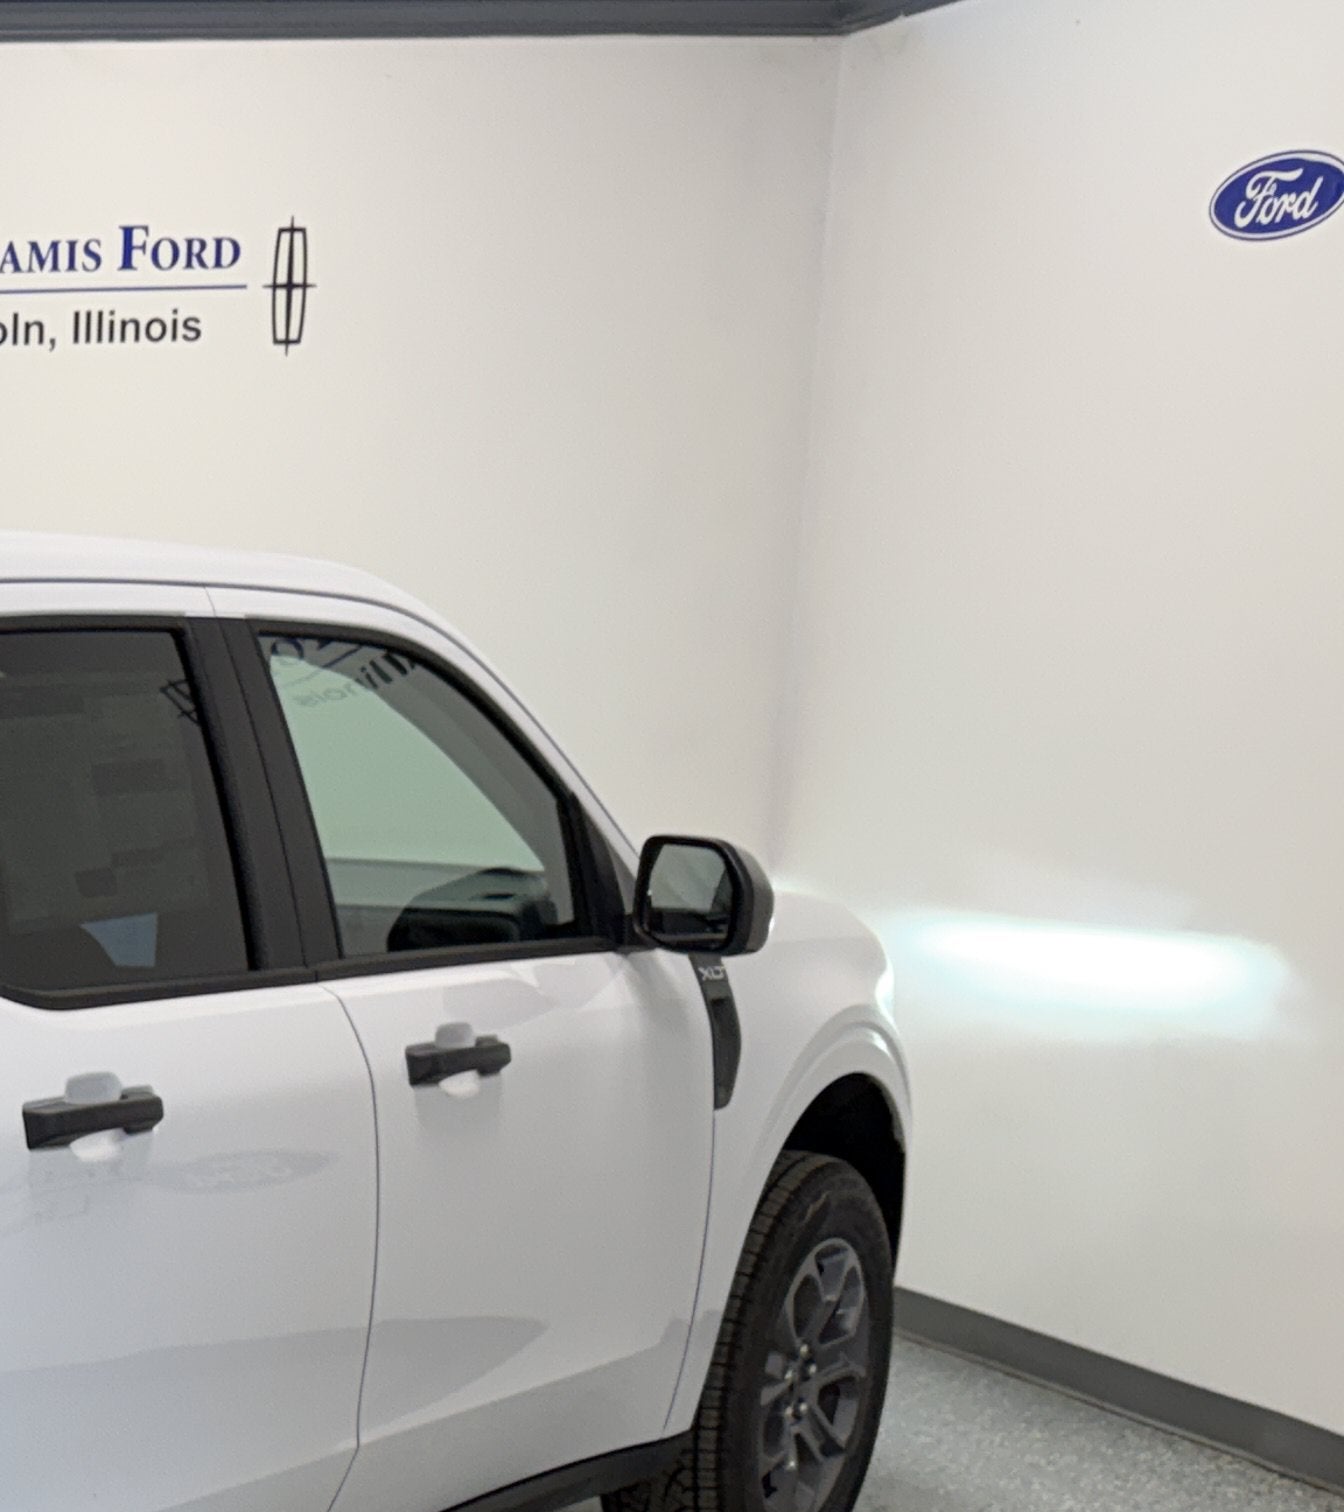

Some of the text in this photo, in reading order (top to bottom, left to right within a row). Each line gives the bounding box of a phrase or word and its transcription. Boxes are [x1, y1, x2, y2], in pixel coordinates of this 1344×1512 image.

[1234, 167, 1324, 228] Ford
[116, 225, 242, 271] FORD
[71, 309, 202, 345] Illinois
